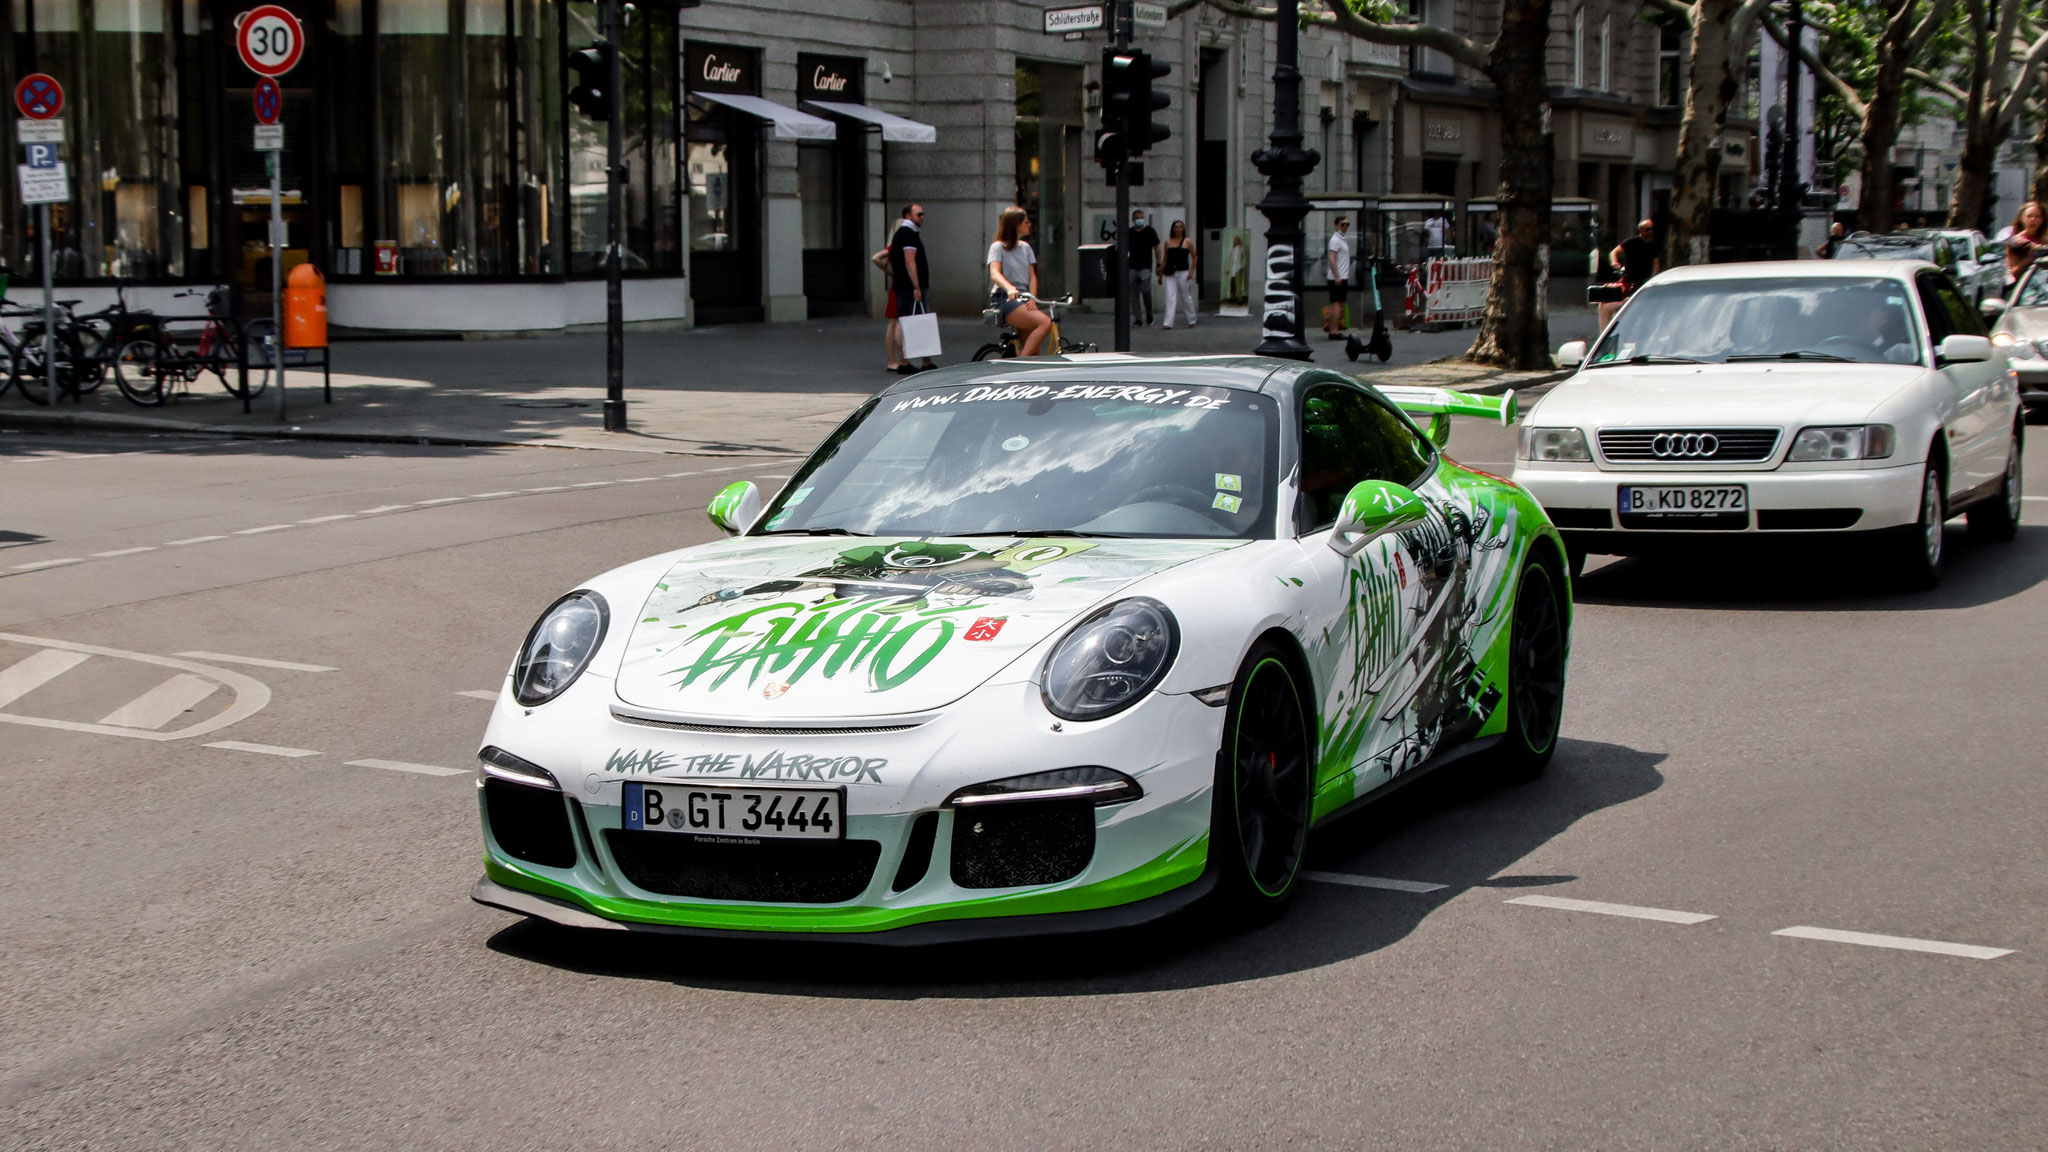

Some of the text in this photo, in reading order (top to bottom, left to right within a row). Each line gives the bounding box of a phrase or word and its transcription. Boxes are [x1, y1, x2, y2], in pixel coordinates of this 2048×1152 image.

[1048, 9, 1100, 26] Schlüterstraße
[252, 26, 288, 56] 30
[703, 54, 741, 82] Cartier
[813, 64, 847, 91] Cartier
[31, 144, 49, 166] P
[1632, 489, 1743, 509] B KD 8272
[604, 748, 889, 784] WAKE THE WARRIOR
[630, 810, 638, 822] D
[644, 789, 833, 833] B GT 3444
[694, 835, 715, 843] Porsche
